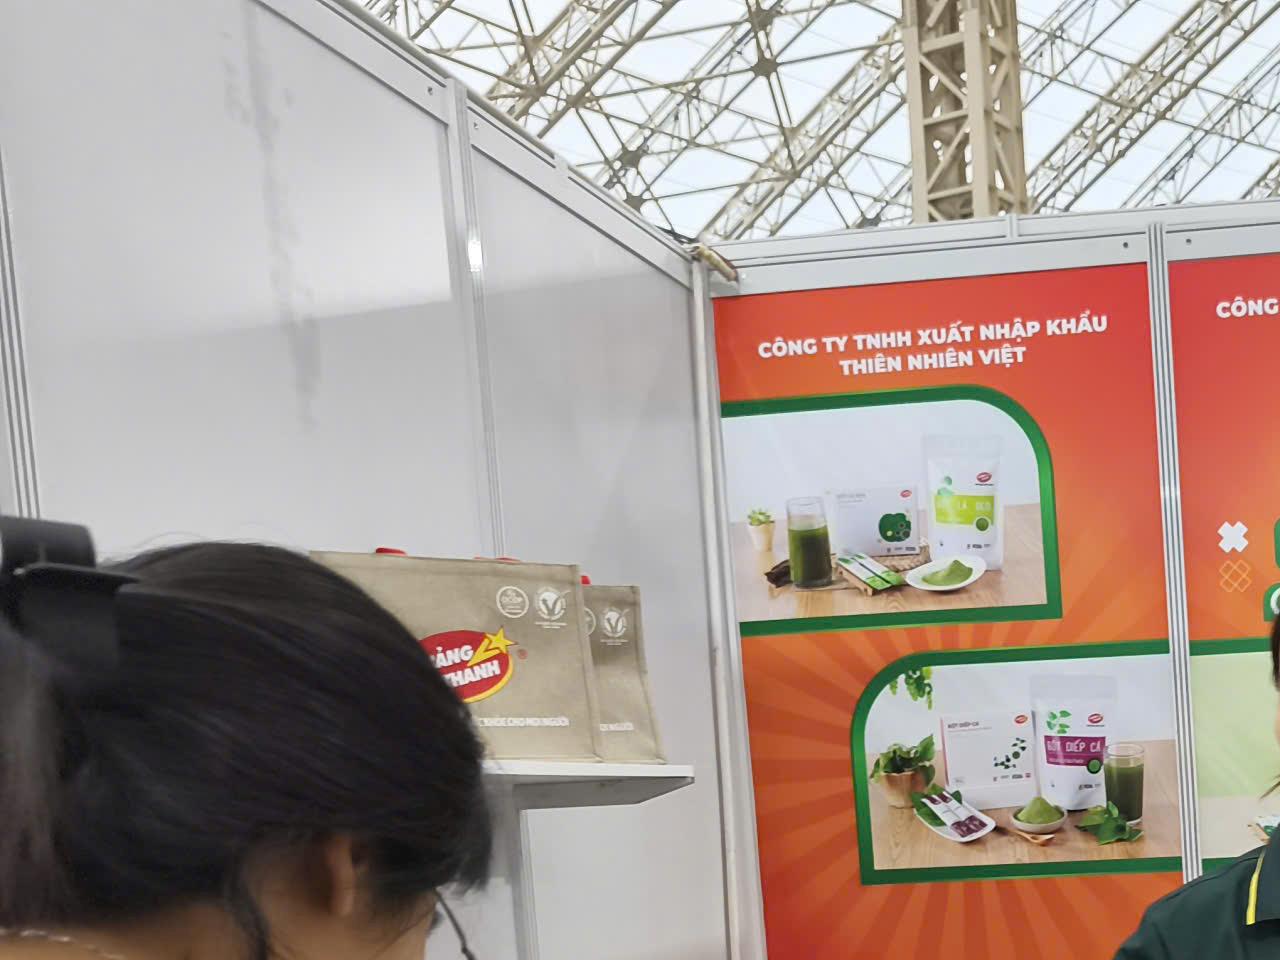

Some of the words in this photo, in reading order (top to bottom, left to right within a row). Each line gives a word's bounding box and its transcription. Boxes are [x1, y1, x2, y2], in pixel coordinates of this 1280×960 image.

[1216, 296, 1278, 319] CÔNG
[758, 336, 818, 359] CÔNG
[823, 336, 848, 353] TY
[853, 332, 912, 350] TNHH
[917, 321, 973, 345] XUẤT
[979, 319, 1041, 341] NHẬP
[1046, 309, 1107, 335] KHẨU
[840, 352, 902, 375] THIÊN
[907, 350, 973, 371] NHIÊN
[979, 346, 1026, 367] VIỆT
[431, 645, 474, 669] ẢNG
